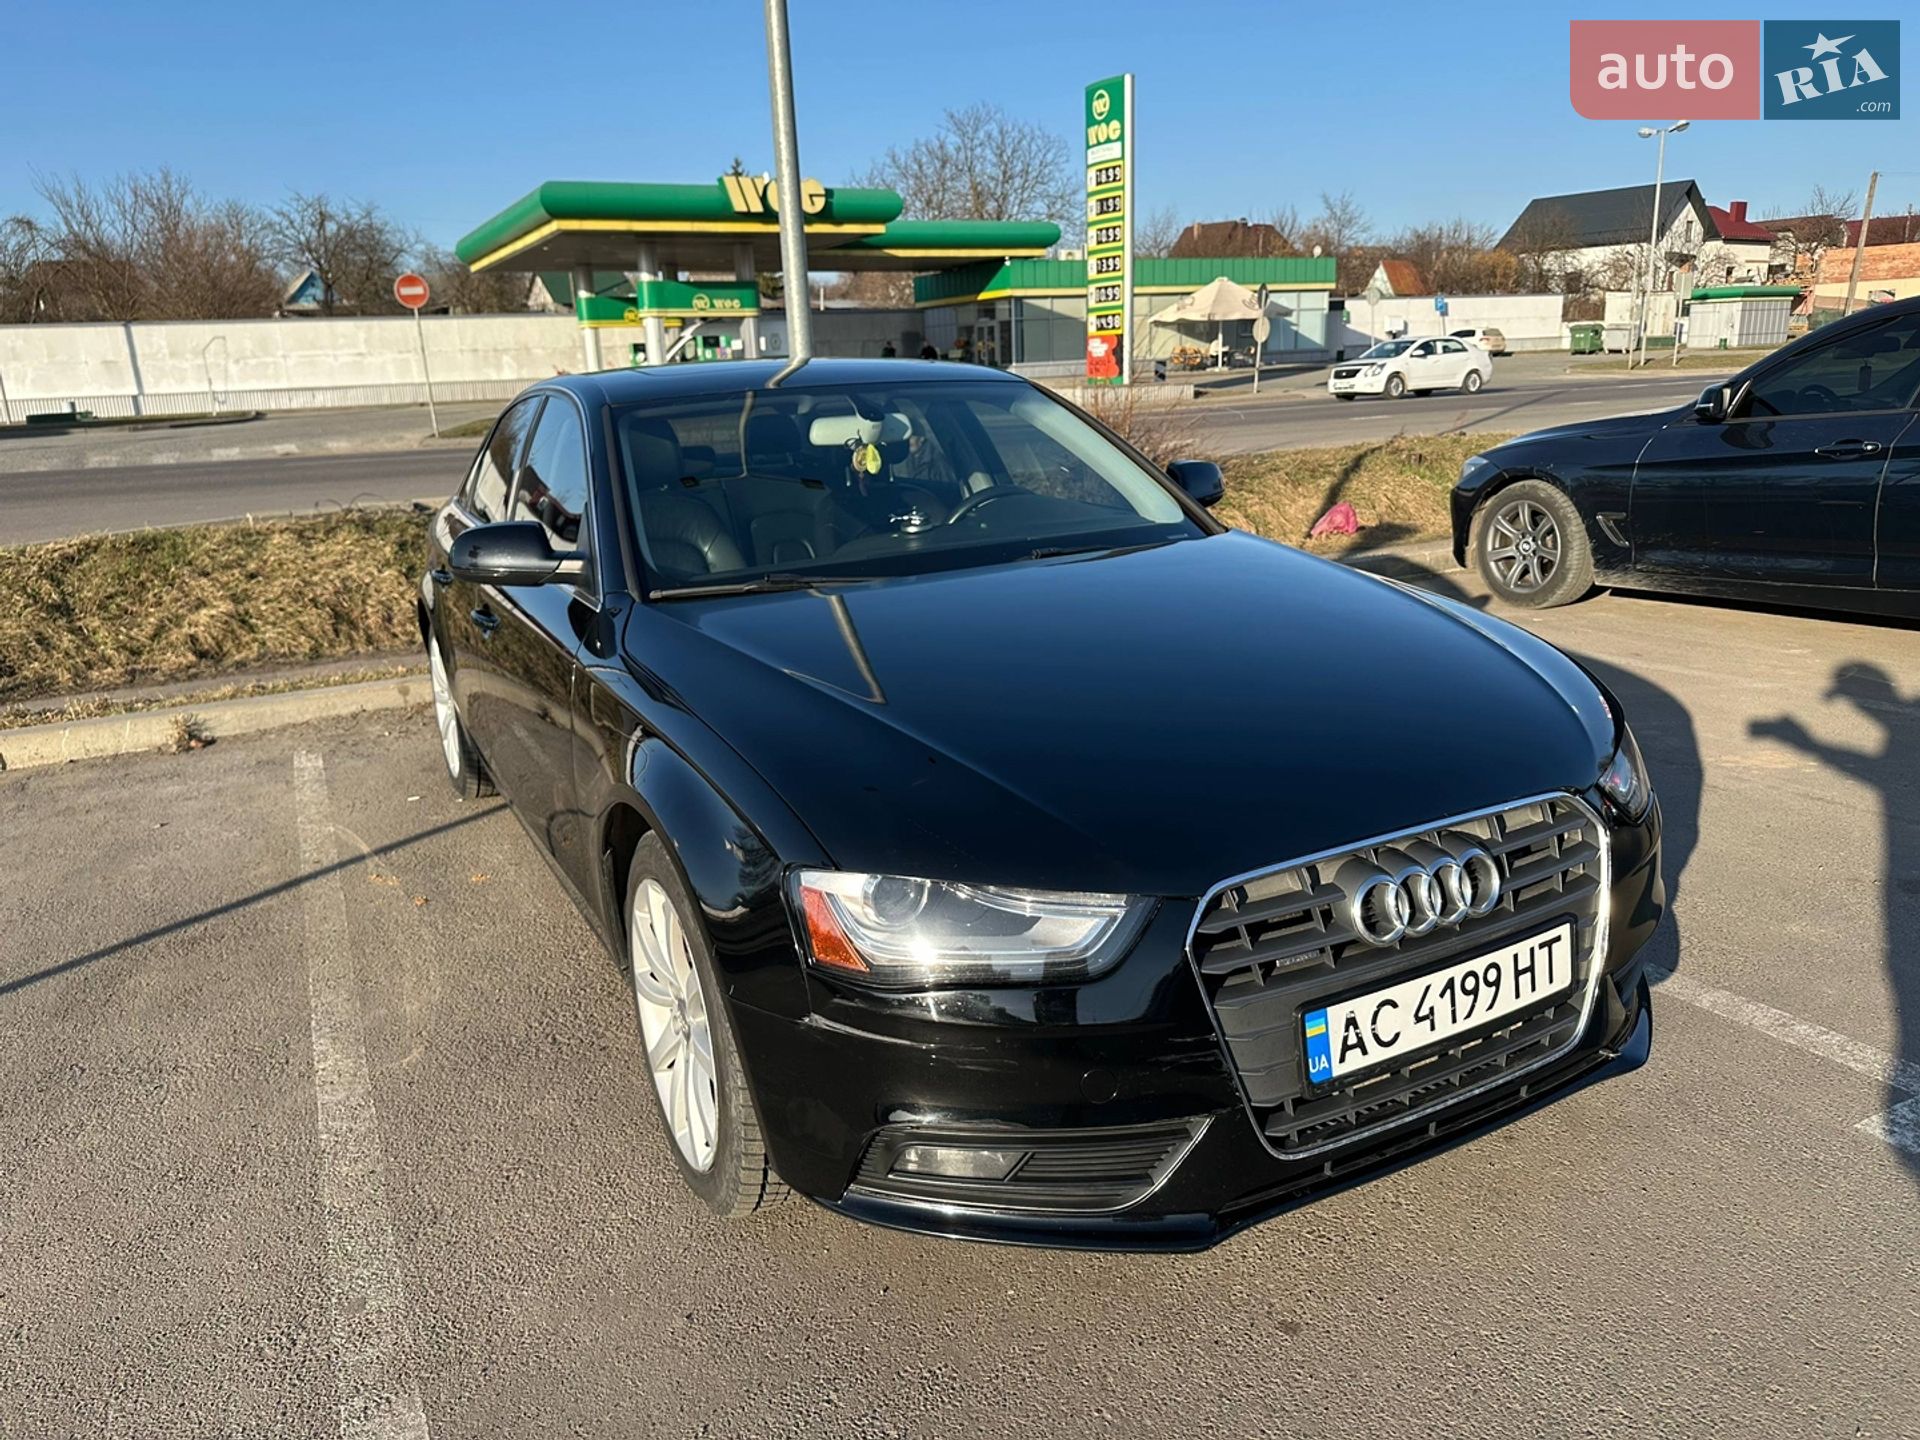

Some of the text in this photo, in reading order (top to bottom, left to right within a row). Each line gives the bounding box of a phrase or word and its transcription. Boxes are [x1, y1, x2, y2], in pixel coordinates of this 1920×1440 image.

[1088, 119, 1121, 146] WOG
[1338, 934, 1562, 1063] AC 4199 HT
[1308, 1055, 1329, 1073] UA
